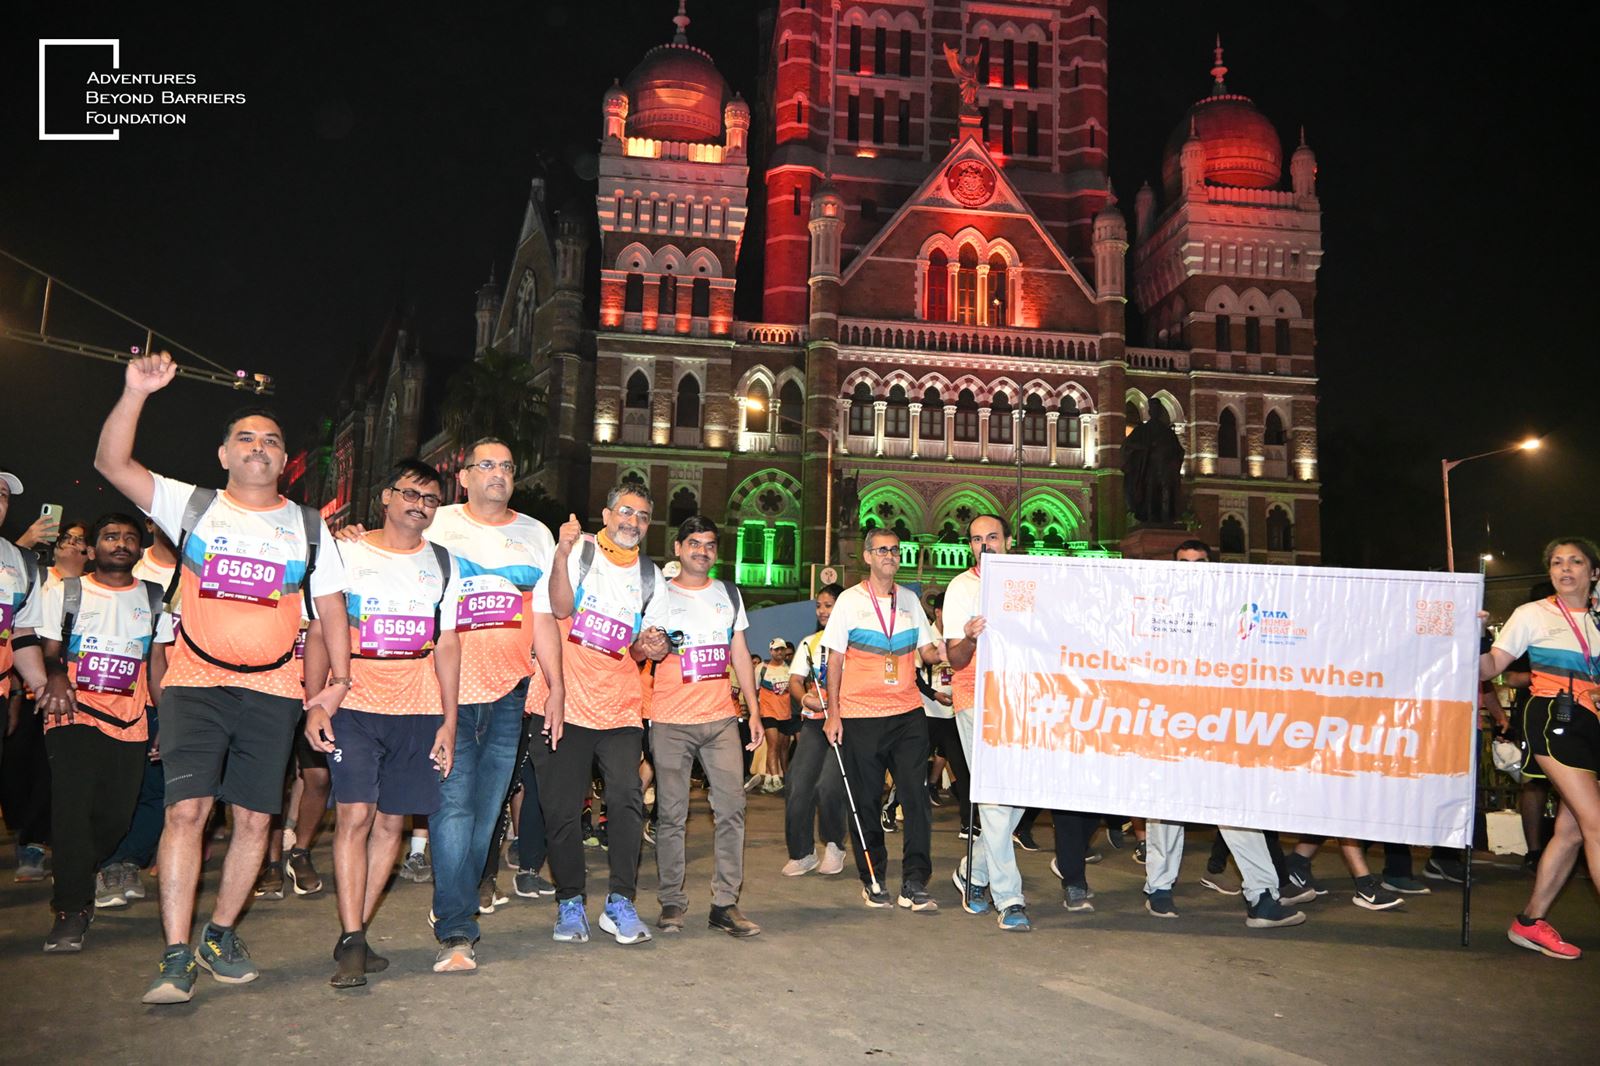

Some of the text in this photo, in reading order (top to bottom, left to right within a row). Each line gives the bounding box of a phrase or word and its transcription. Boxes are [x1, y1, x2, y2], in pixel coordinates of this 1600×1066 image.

[216, 558, 276, 583] 65630
[468, 595, 515, 611] 65627
[1261, 610, 1288, 619] TATA
[373, 618, 426, 636] 65694
[584, 614, 627, 640] 65613
[689, 648, 726, 663] 65788
[88, 656, 136, 676] 65759
[1194, 658, 1294, 687] begins
[1301, 664, 1385, 688] when
[1028, 694, 1420, 758] #UnitedWeRun
